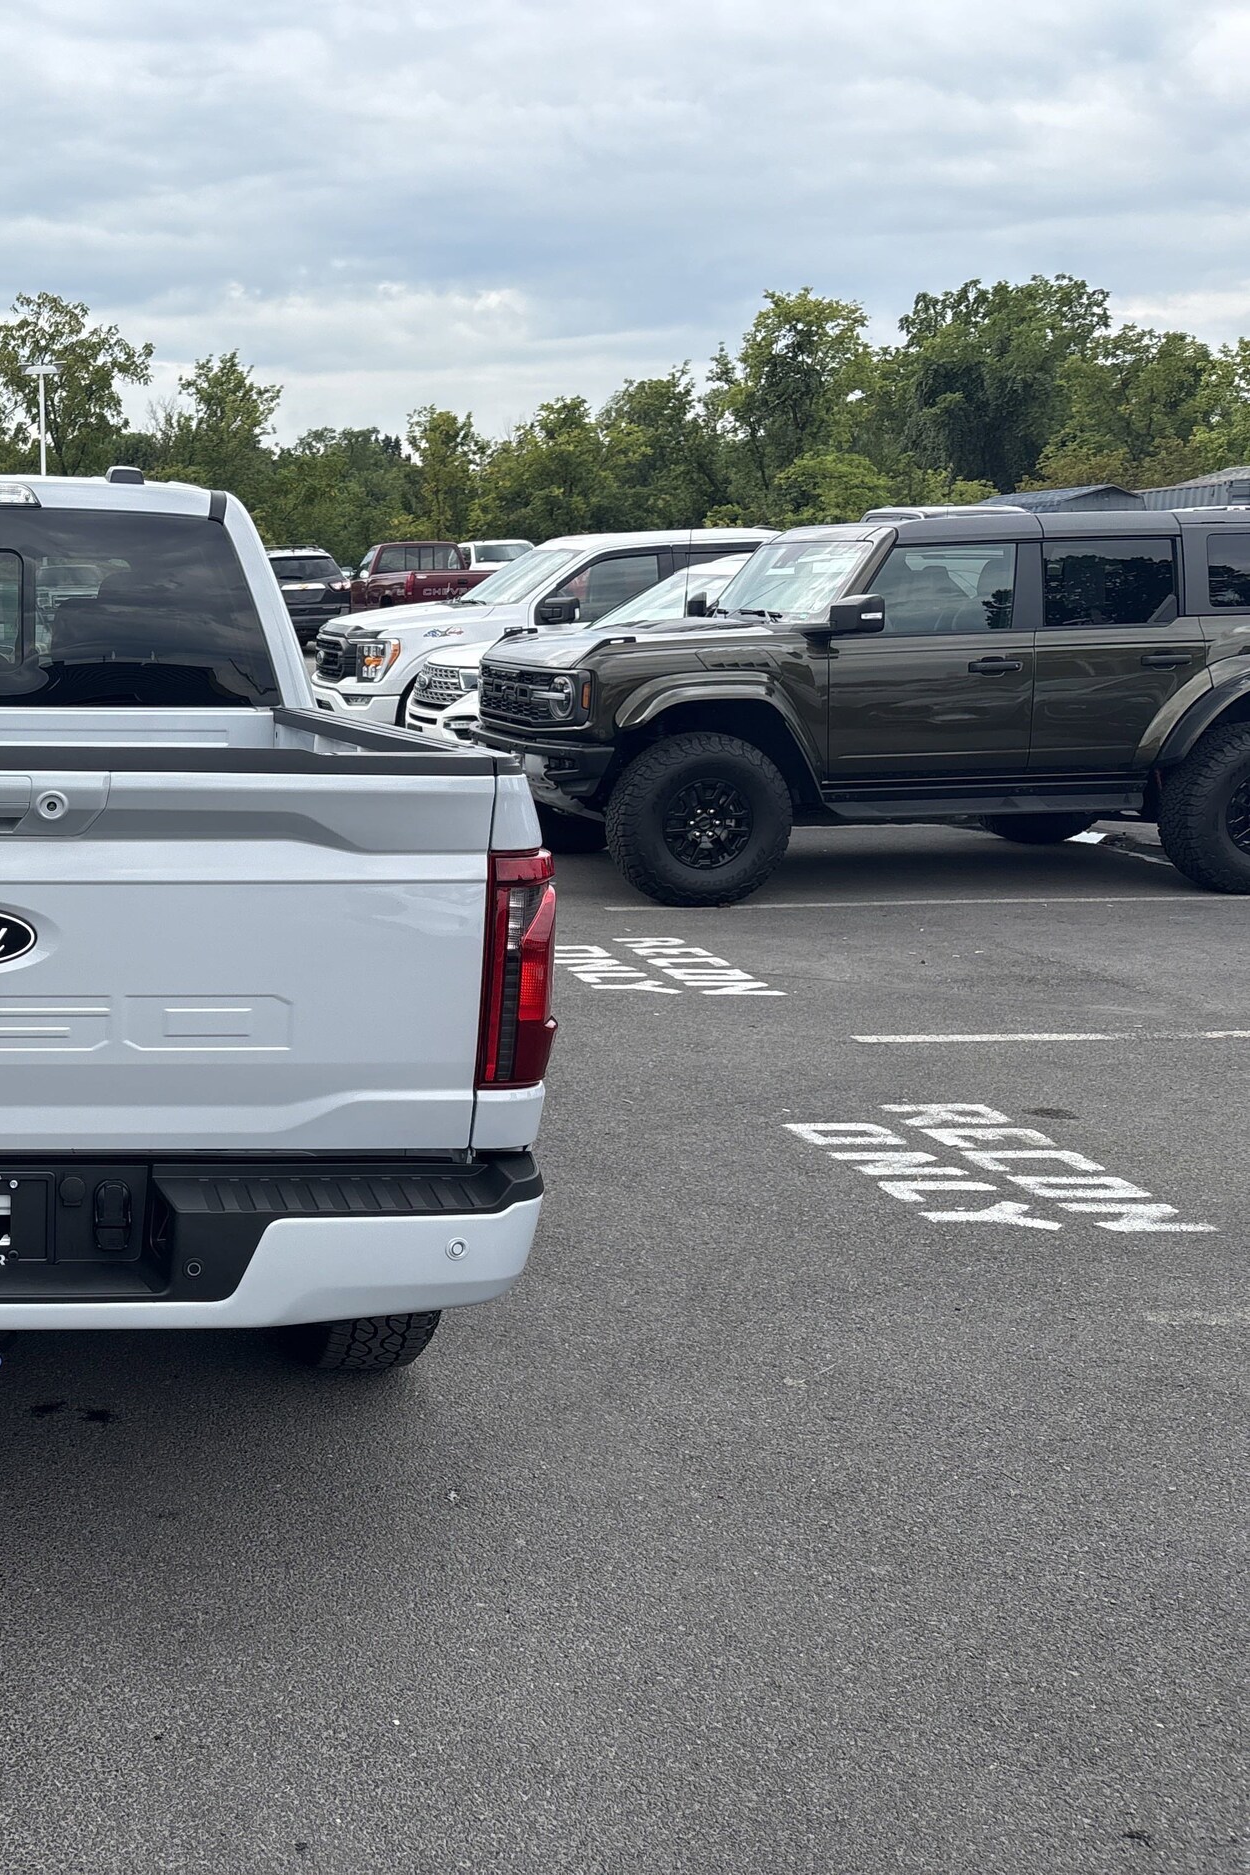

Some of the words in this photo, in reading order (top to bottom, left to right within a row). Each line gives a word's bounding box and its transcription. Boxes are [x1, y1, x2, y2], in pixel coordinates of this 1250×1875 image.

[554, 945, 684, 995] ONLY
[612, 937, 789, 996] RECON
[782, 1122, 1063, 1230] ONLY
[878, 1103, 1219, 1232] RECON
